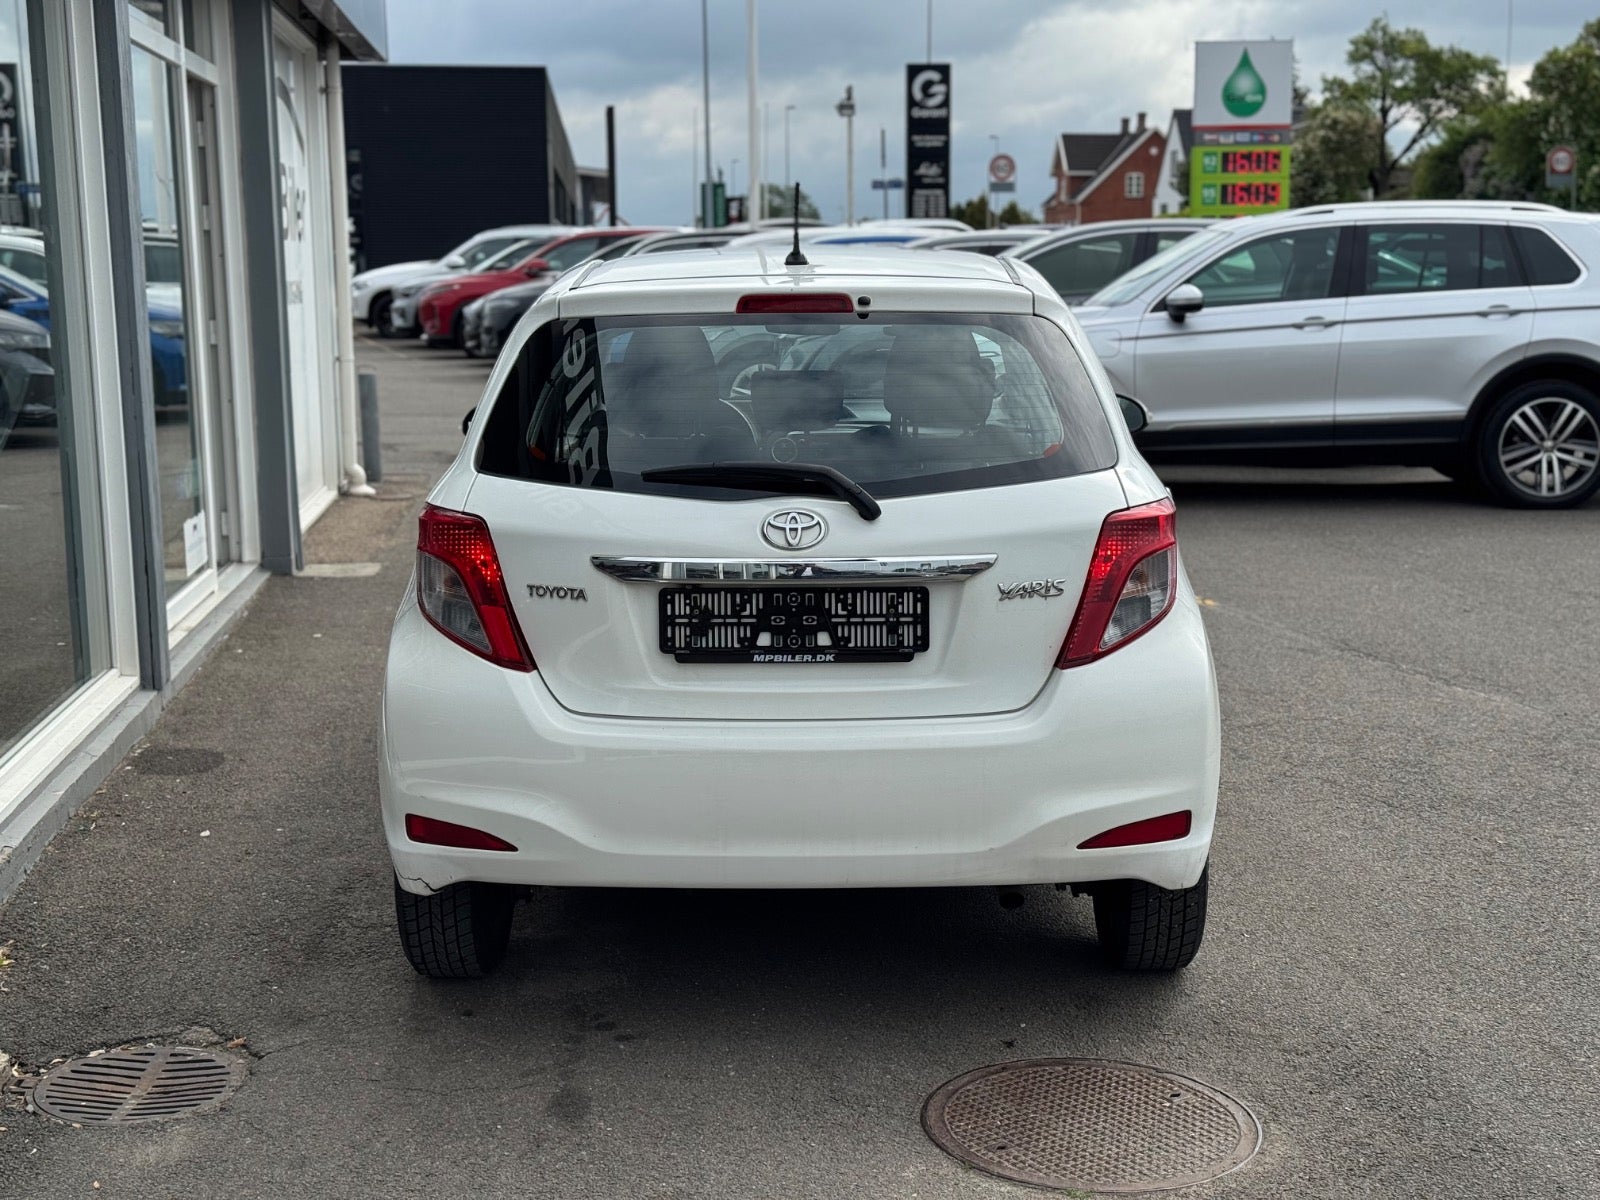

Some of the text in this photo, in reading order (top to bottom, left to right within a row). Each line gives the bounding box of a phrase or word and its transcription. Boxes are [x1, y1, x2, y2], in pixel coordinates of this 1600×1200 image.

[526, 583, 588, 602] TOYOTA
[997, 578, 1066, 601] YARIS
[753, 654, 836, 662] MPBILER.DK
